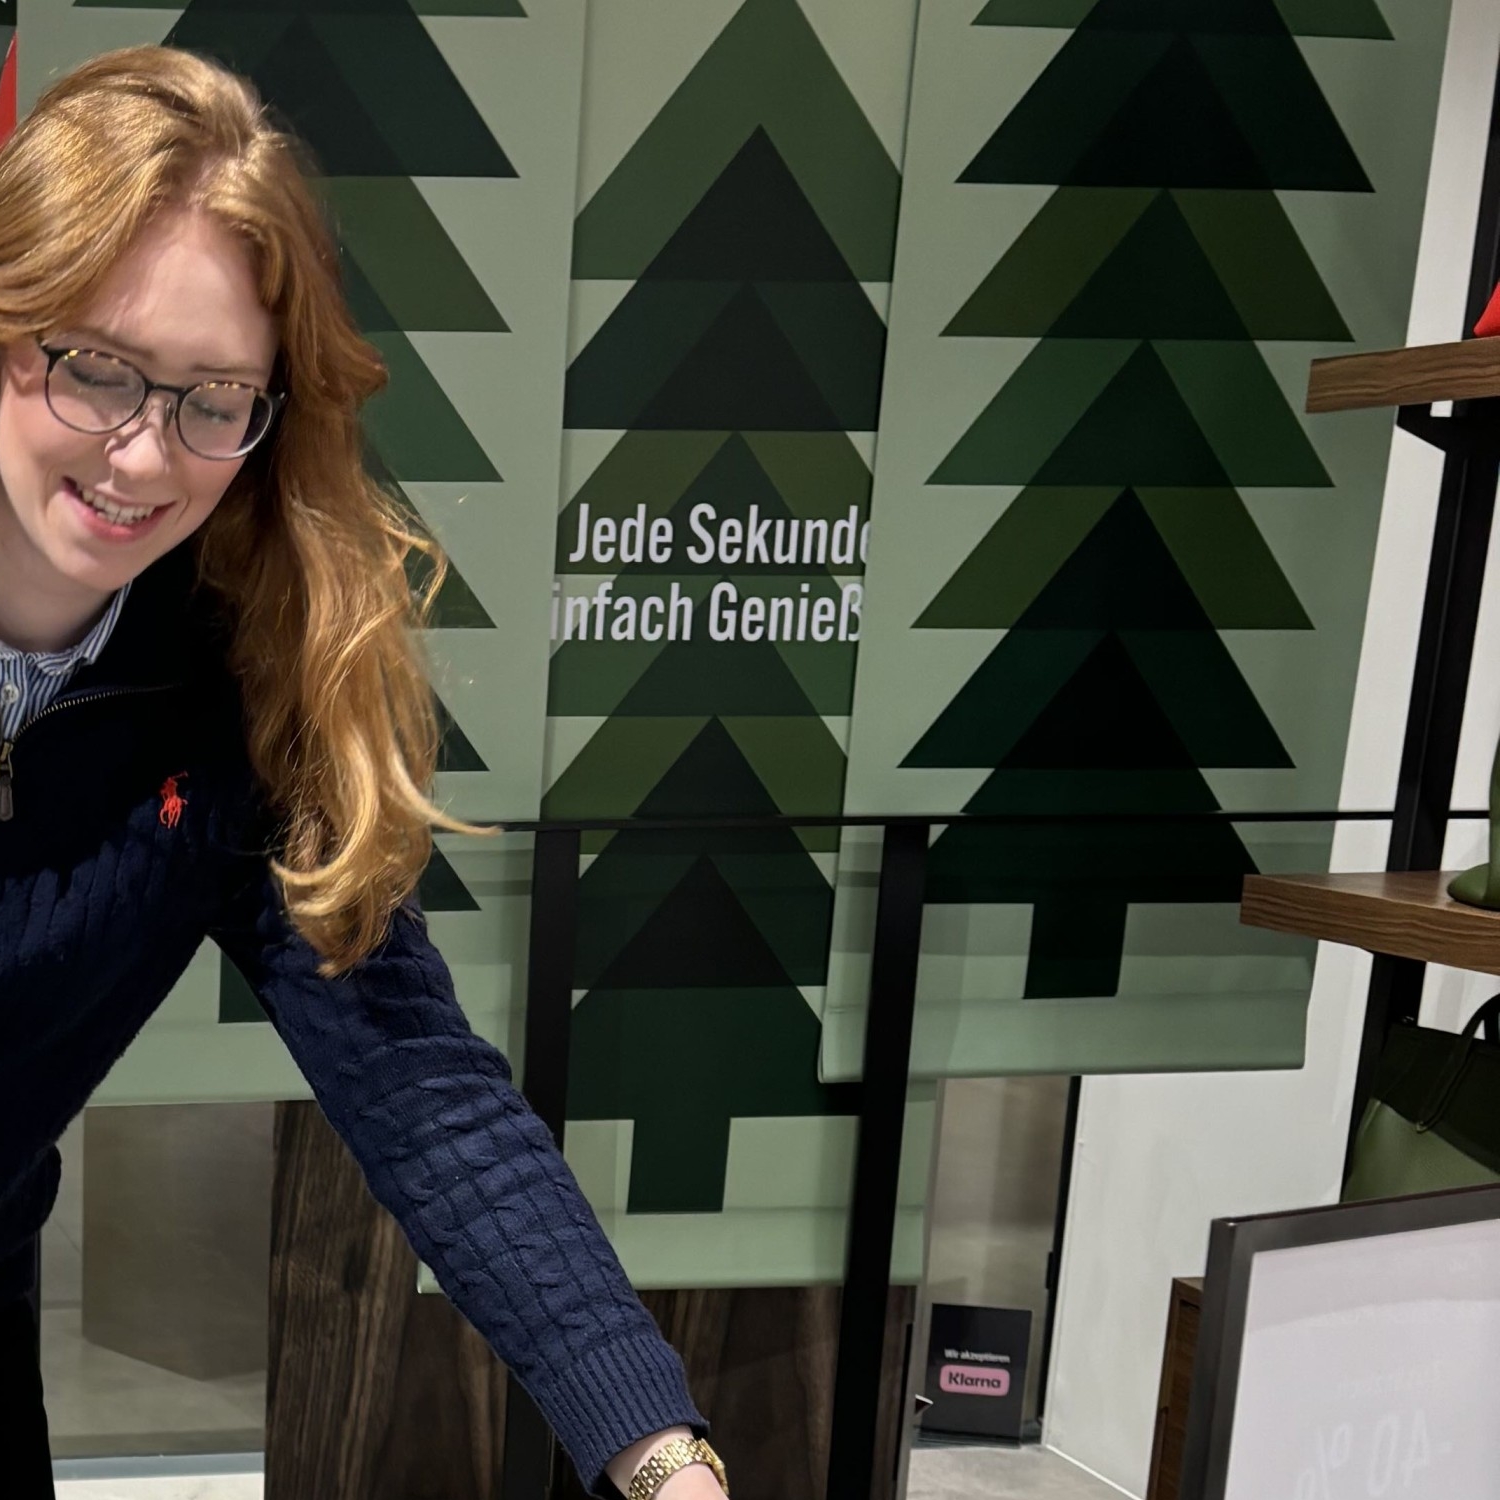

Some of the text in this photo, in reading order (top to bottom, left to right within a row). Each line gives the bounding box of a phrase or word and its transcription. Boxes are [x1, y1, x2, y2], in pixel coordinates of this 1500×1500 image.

[568, 503, 674, 563] Jede
[708, 581, 865, 641] Genieß
[948, 1371, 1002, 1389] Klarna
